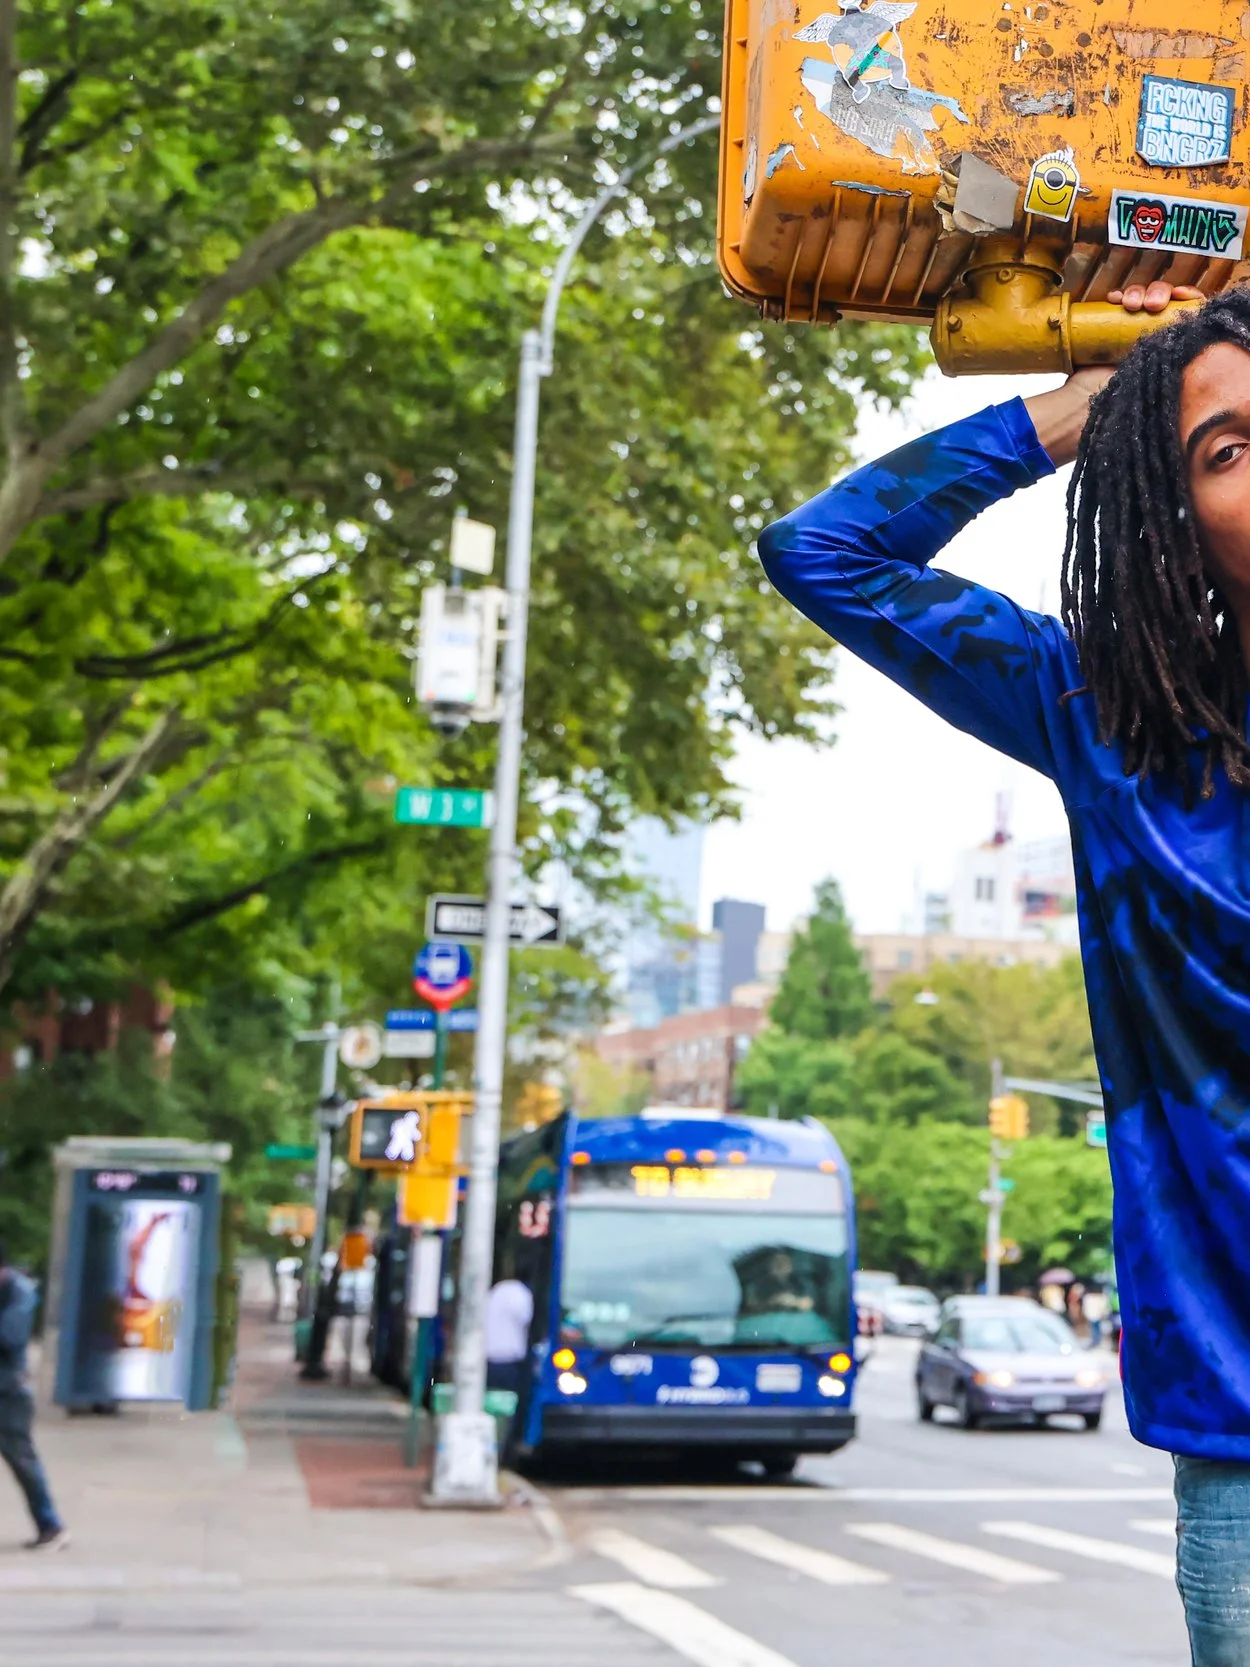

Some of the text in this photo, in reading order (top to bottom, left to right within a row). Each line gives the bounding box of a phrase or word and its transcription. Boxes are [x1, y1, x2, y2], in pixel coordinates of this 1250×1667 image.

[1146, 81, 1228, 125] FCKNG
[1145, 112, 1228, 141] THE WORLD IS
[1142, 127, 1229, 164] BNGRZ
